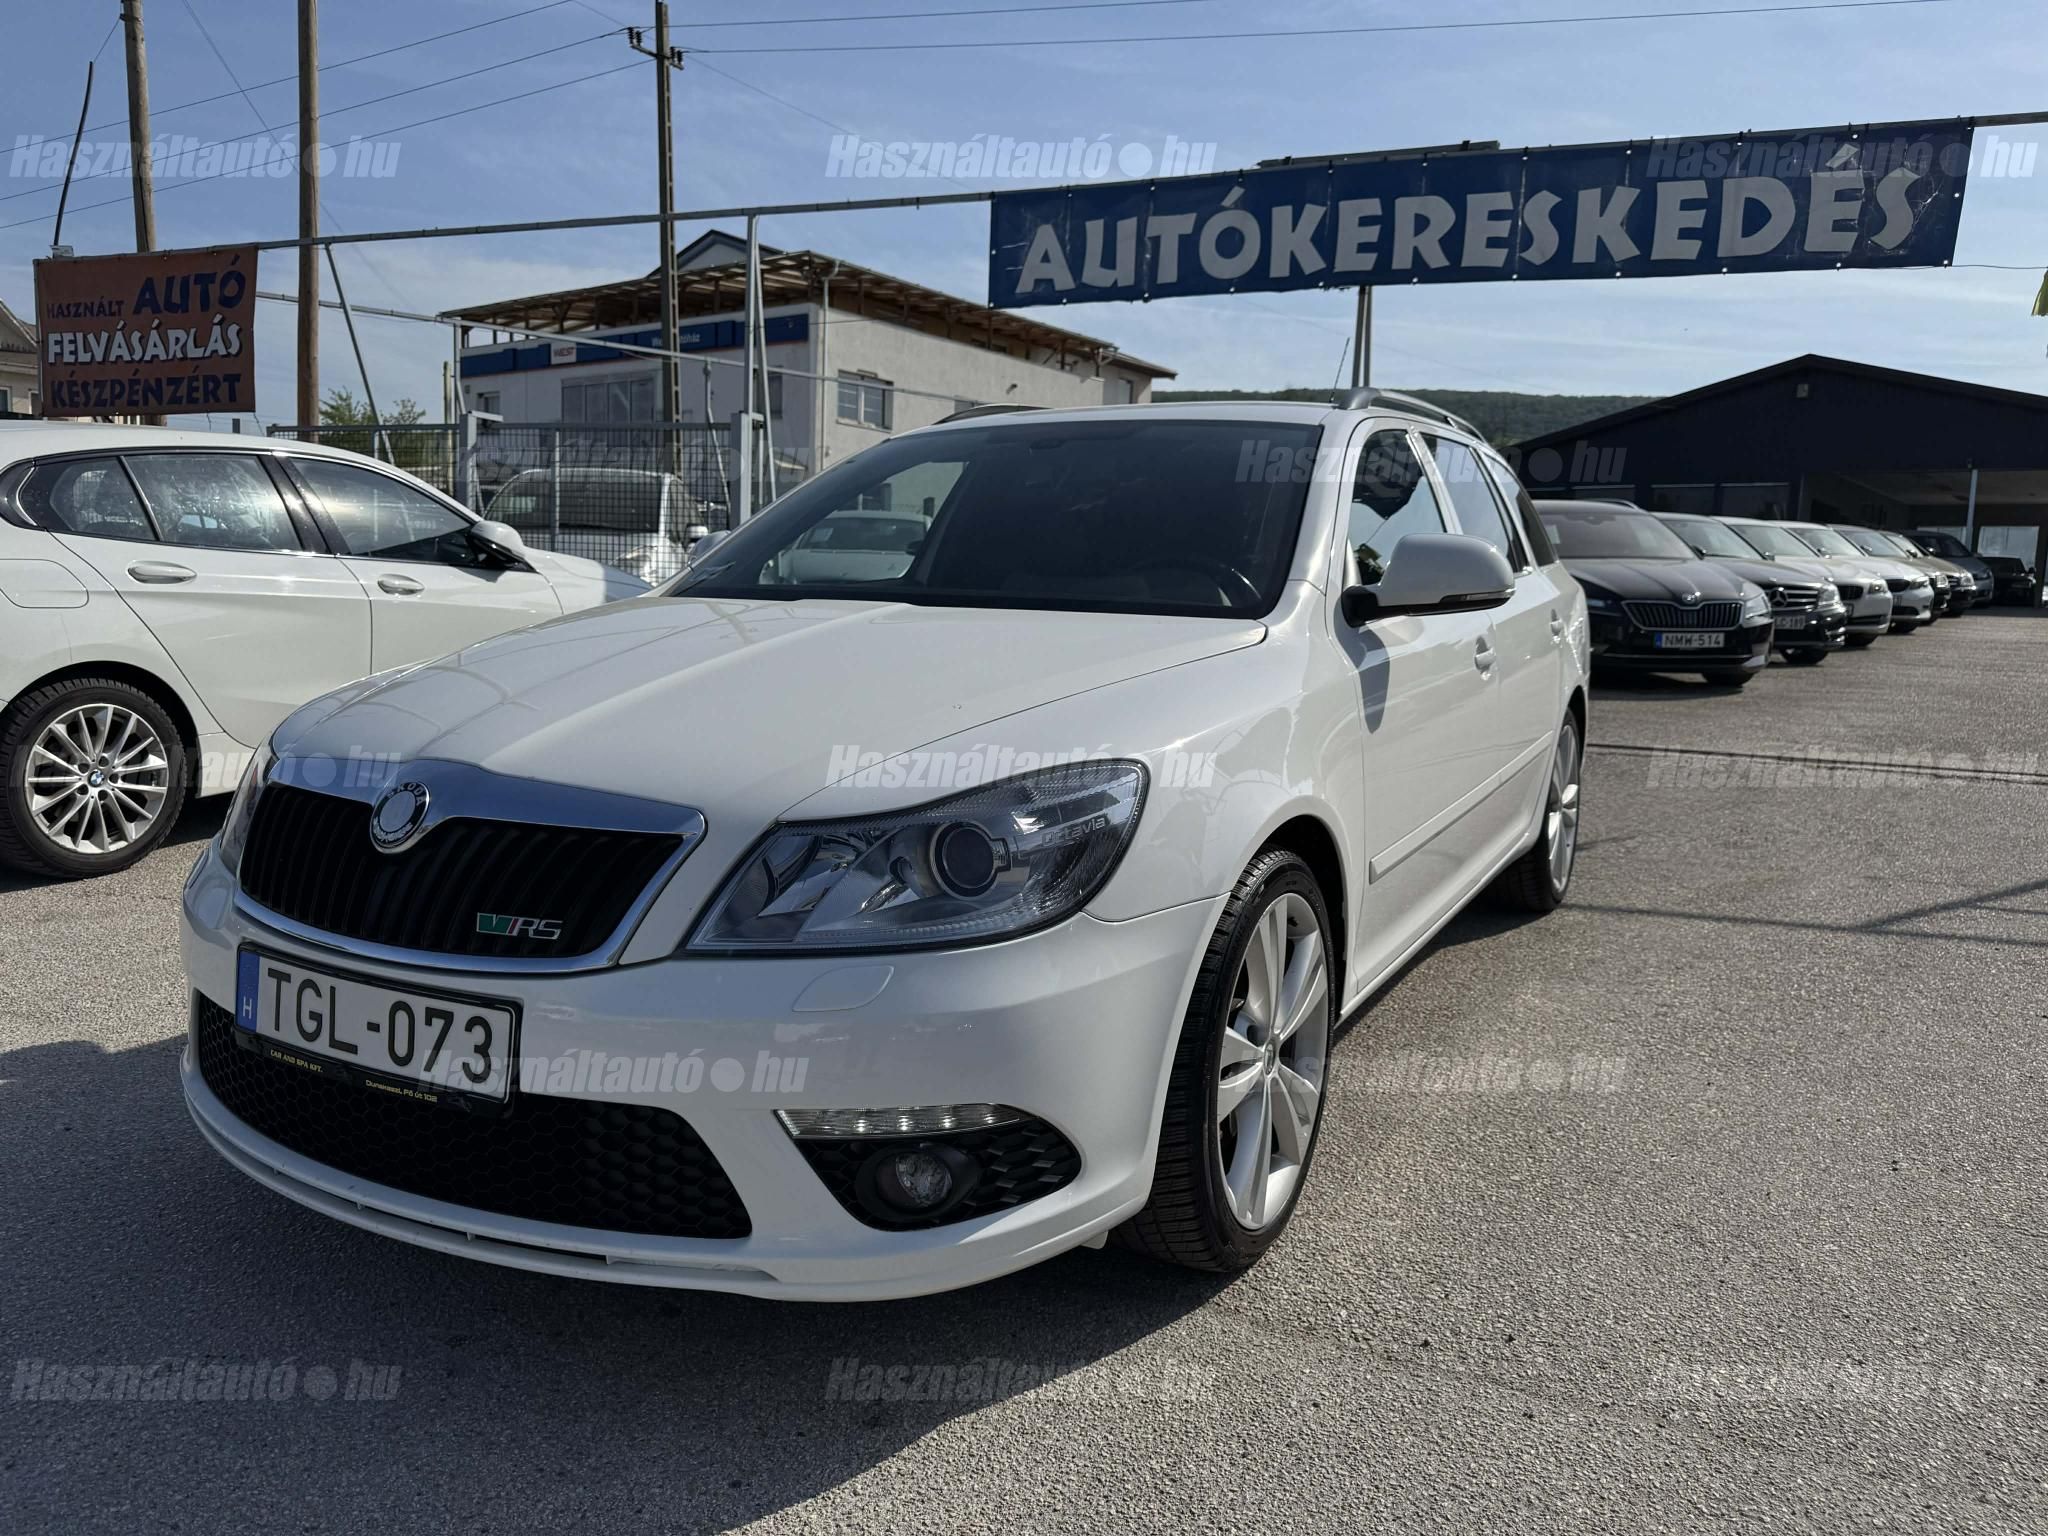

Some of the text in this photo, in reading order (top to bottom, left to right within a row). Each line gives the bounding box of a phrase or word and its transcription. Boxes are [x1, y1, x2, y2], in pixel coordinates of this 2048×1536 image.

[1015, 143, 1921, 294] AUTÓKERESKEDÉS
[47, 254, 246, 319] HASZNÁLT AUTÓ
[47, 313, 242, 365] FELVÁSÁRLÁS
[51, 366, 242, 409] KÉSZPÉNZÉRT
[1664, 634, 1721, 646] NMW-514
[242, 967, 493, 1084] H TGL-073
